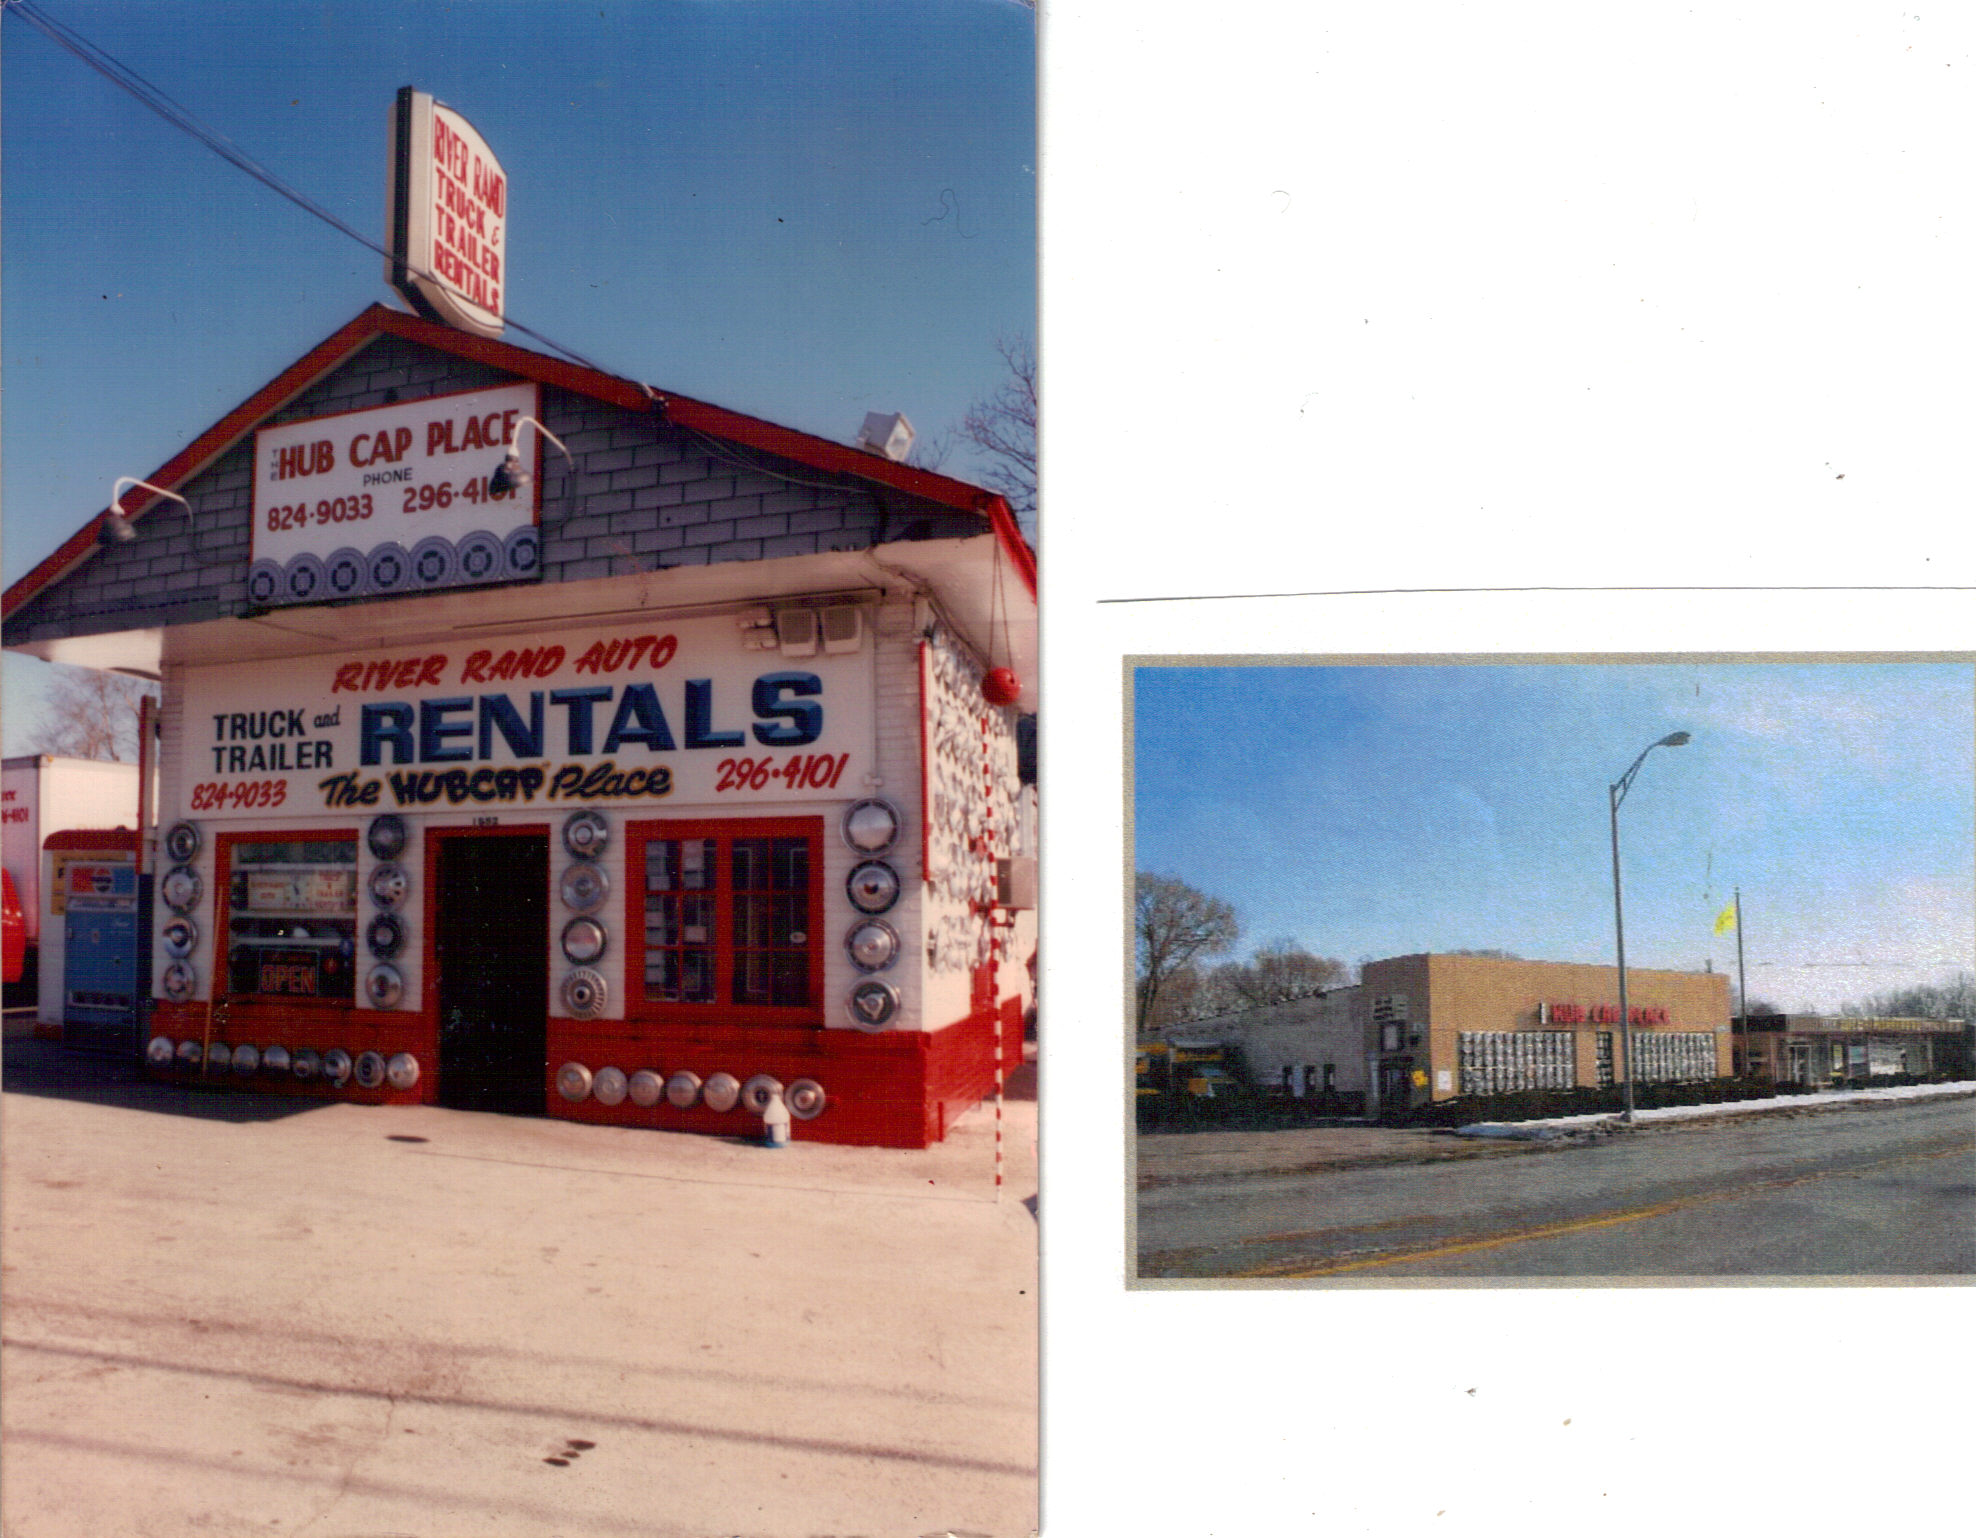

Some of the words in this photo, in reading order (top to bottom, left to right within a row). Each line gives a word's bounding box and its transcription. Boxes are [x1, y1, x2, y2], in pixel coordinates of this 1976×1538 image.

[434, 114, 468, 187] RIVER
[473, 154, 504, 219] RAND
[436, 166, 485, 239] TRUCK
[435, 202, 500, 285] TRAILER
[434, 238, 499, 318] RENTALS
[279, 439, 335, 480] HUB
[350, 427, 413, 468] CAP
[426, 409, 519, 457] PLACE
[363, 467, 413, 487] PHONE
[331, 653, 448, 694] RIVER
[460, 645, 565, 685] RAND
[575, 634, 678, 675] AUTO
[213, 708, 305, 741] TRUCK
[313, 705, 341, 728] and
[360, 671, 823, 766] RENTALS
[211, 740, 334, 774] TRAILER
[318, 769, 382, 807] The
[386, 764, 546, 807] HUBCAP
[547, 762, 672, 801] Place
[261, 964, 316, 992] OPEN
